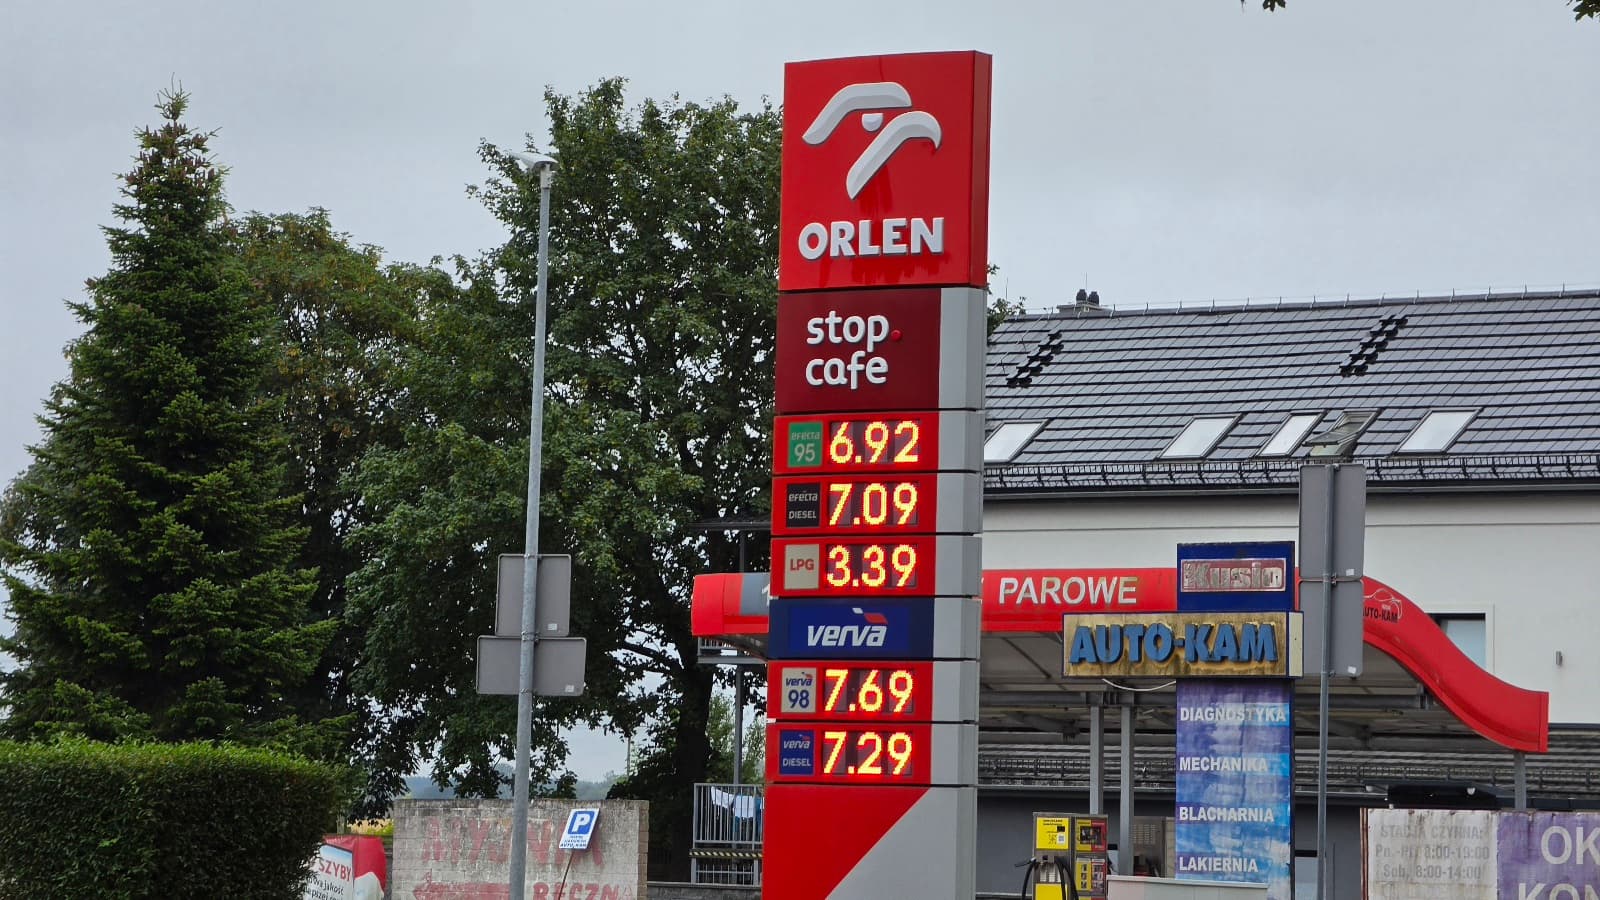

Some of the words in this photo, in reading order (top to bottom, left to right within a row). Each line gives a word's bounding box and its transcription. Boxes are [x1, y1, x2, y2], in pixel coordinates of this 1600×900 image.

[798, 217, 944, 260] ORLEN
[806, 310, 889, 352] stop
[805, 350, 889, 389] cafe
[829, 420, 919, 464] 6.92
[794, 443, 816, 462] 95
[788, 510, 816, 519] DIESEL
[829, 483, 917, 526] 7.09
[790, 558, 814, 571] LPG
[826, 545, 917, 588] 3.39
[999, 576, 1138, 605] PAROWE
[1363, 606, 1398, 623] UTO-KAM
[807, 625, 888, 647] verva
[1068, 622, 1279, 664] AUTO-KAM
[785, 677, 812, 687] verva
[825, 669, 913, 712] 7.69
[788, 690, 810, 708] 98
[1180, 706, 1287, 722] DIAGNOSTYKA
[783, 739, 811, 749] verva
[824, 732, 913, 775] 7.29
[782, 757, 812, 767] DIESEL
[1179, 756, 1268, 772] MECHANIKA
[572, 813, 590, 833] P
[1179, 806, 1274, 822] BLACHARNIA
[319, 857, 351, 882] SZYBY
[1179, 857, 1258, 873] LAKIERNIA
